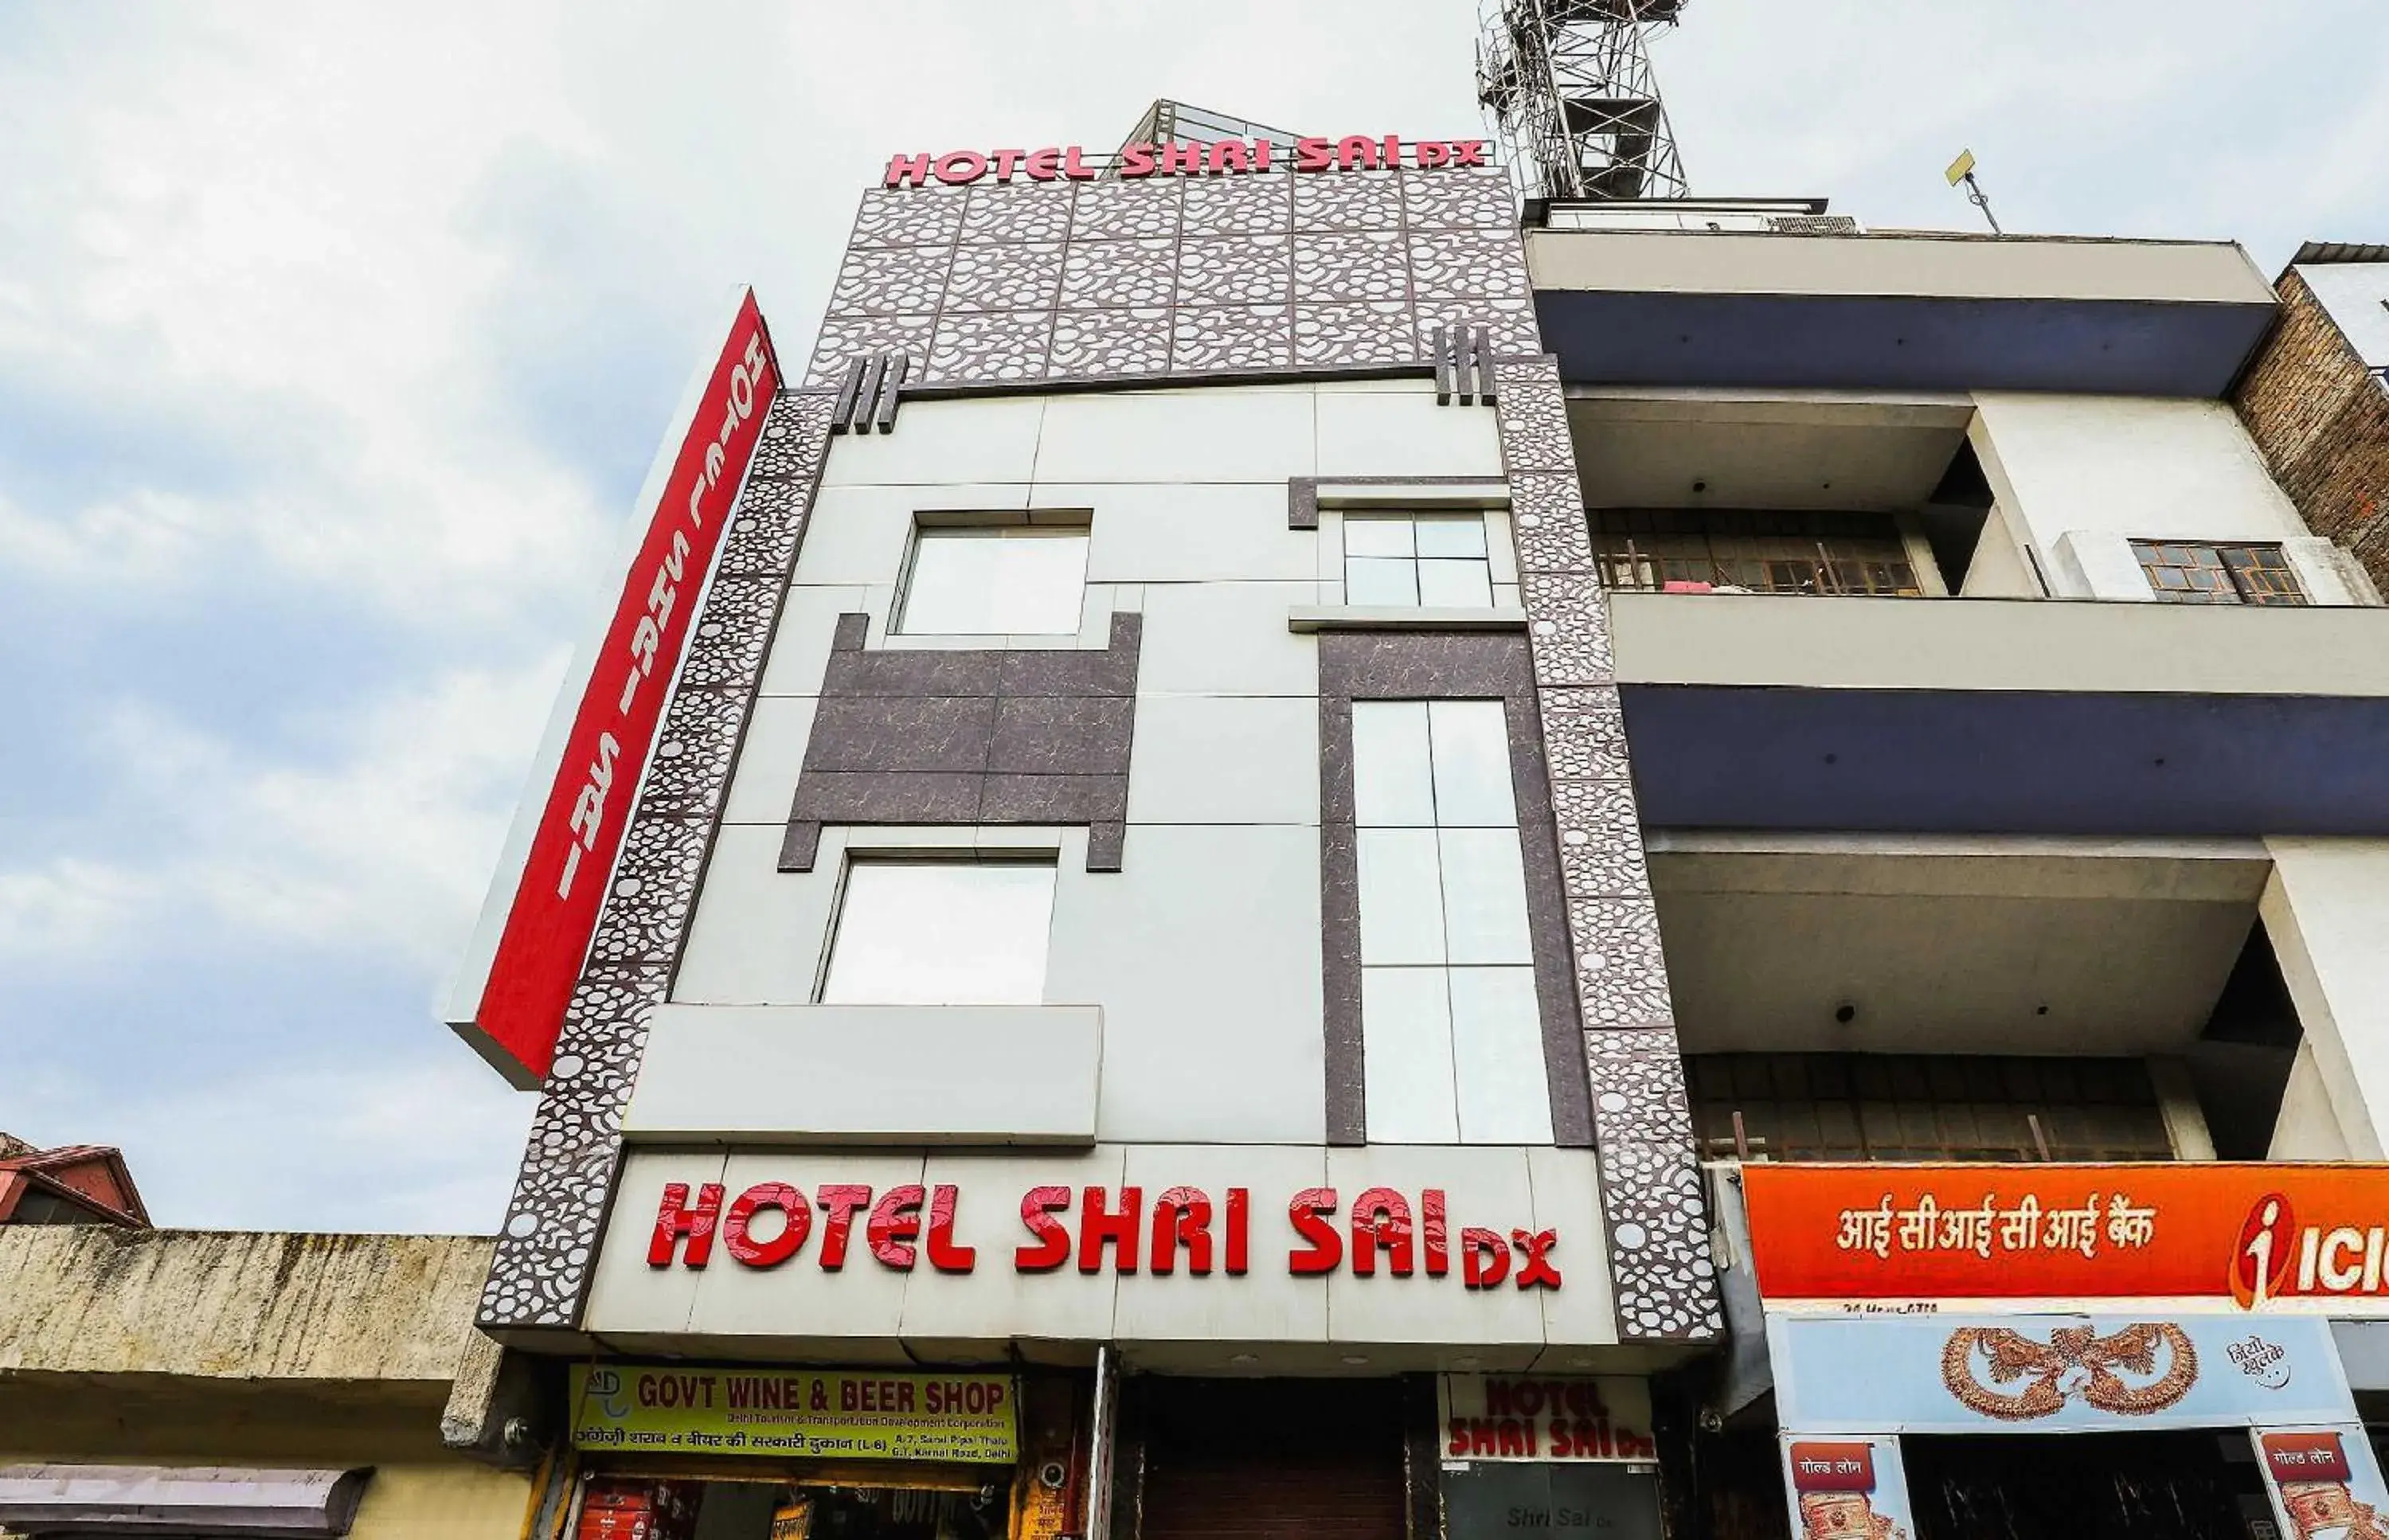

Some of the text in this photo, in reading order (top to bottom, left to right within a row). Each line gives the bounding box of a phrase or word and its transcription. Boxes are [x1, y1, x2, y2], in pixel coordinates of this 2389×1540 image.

[886, 146, 1095, 188] HOTEL
[1120, 139, 1271, 179] SHRI
[1297, 135, 1400, 174] SAI
[557, 330, 766, 901] HOTEL SHRI SAI
[646, 1181, 976, 1273] HOTEL
[1014, 1185, 1249, 1275] SHRI
[1289, 1186, 1449, 1277] SAI
[2107, 1194, 2156, 1248] बैंक
[2297, 1226, 2389, 1292] ICI
[638, 1374, 717, 1408] GOVT
[726, 1377, 800, 1409] WINE
[810, 1378, 829, 1411] &
[841, 1380, 915, 1413] BEER
[925, 1382, 1003, 1415] SHOP
[1485, 1379, 1609, 1417] HOTEL
[1449, 1417, 1537, 1457] SHRI
[1550, 1417, 1612, 1457] SAI
